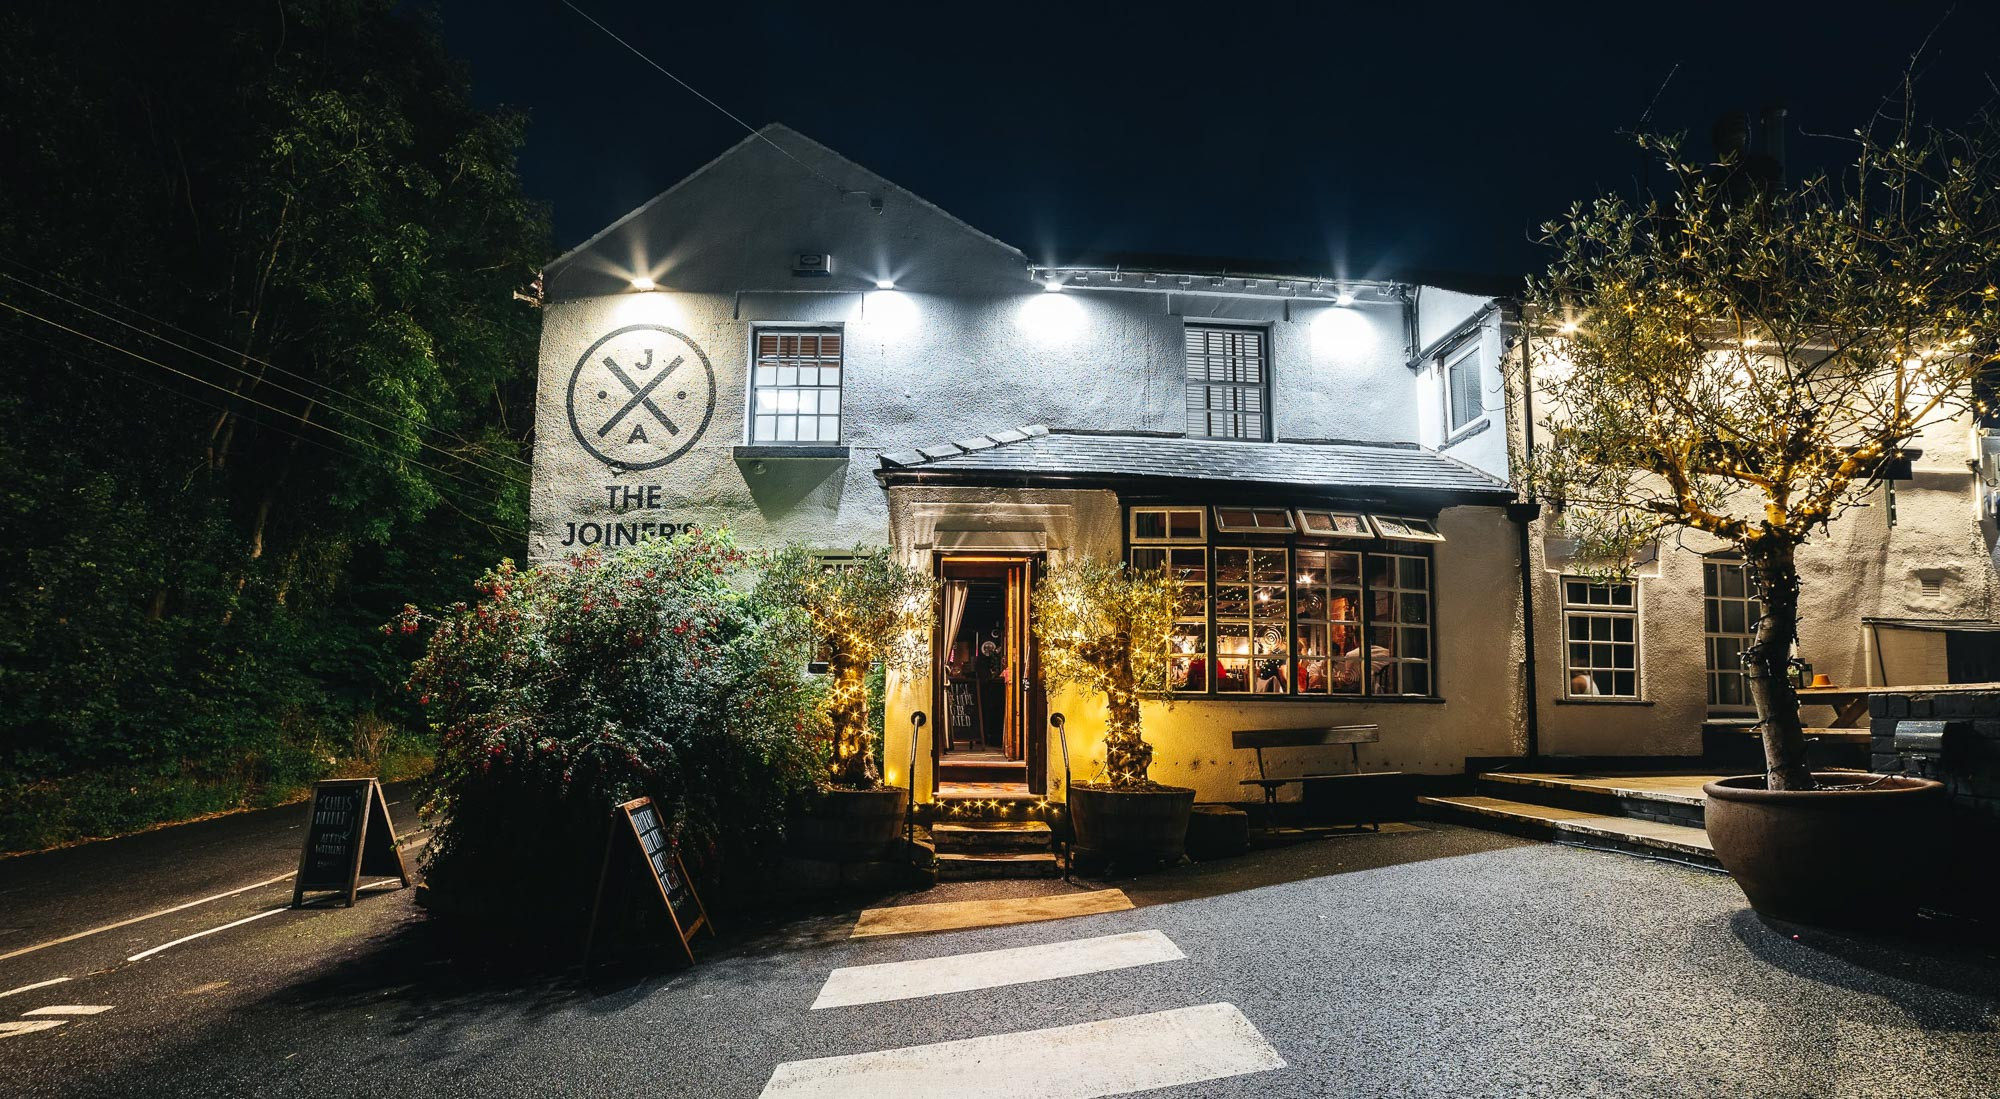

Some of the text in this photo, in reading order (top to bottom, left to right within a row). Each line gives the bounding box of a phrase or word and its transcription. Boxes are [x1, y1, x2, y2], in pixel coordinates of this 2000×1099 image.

[635, 349, 653, 371] J
[627, 424, 649, 444] A
[605, 485, 662, 510] THE
